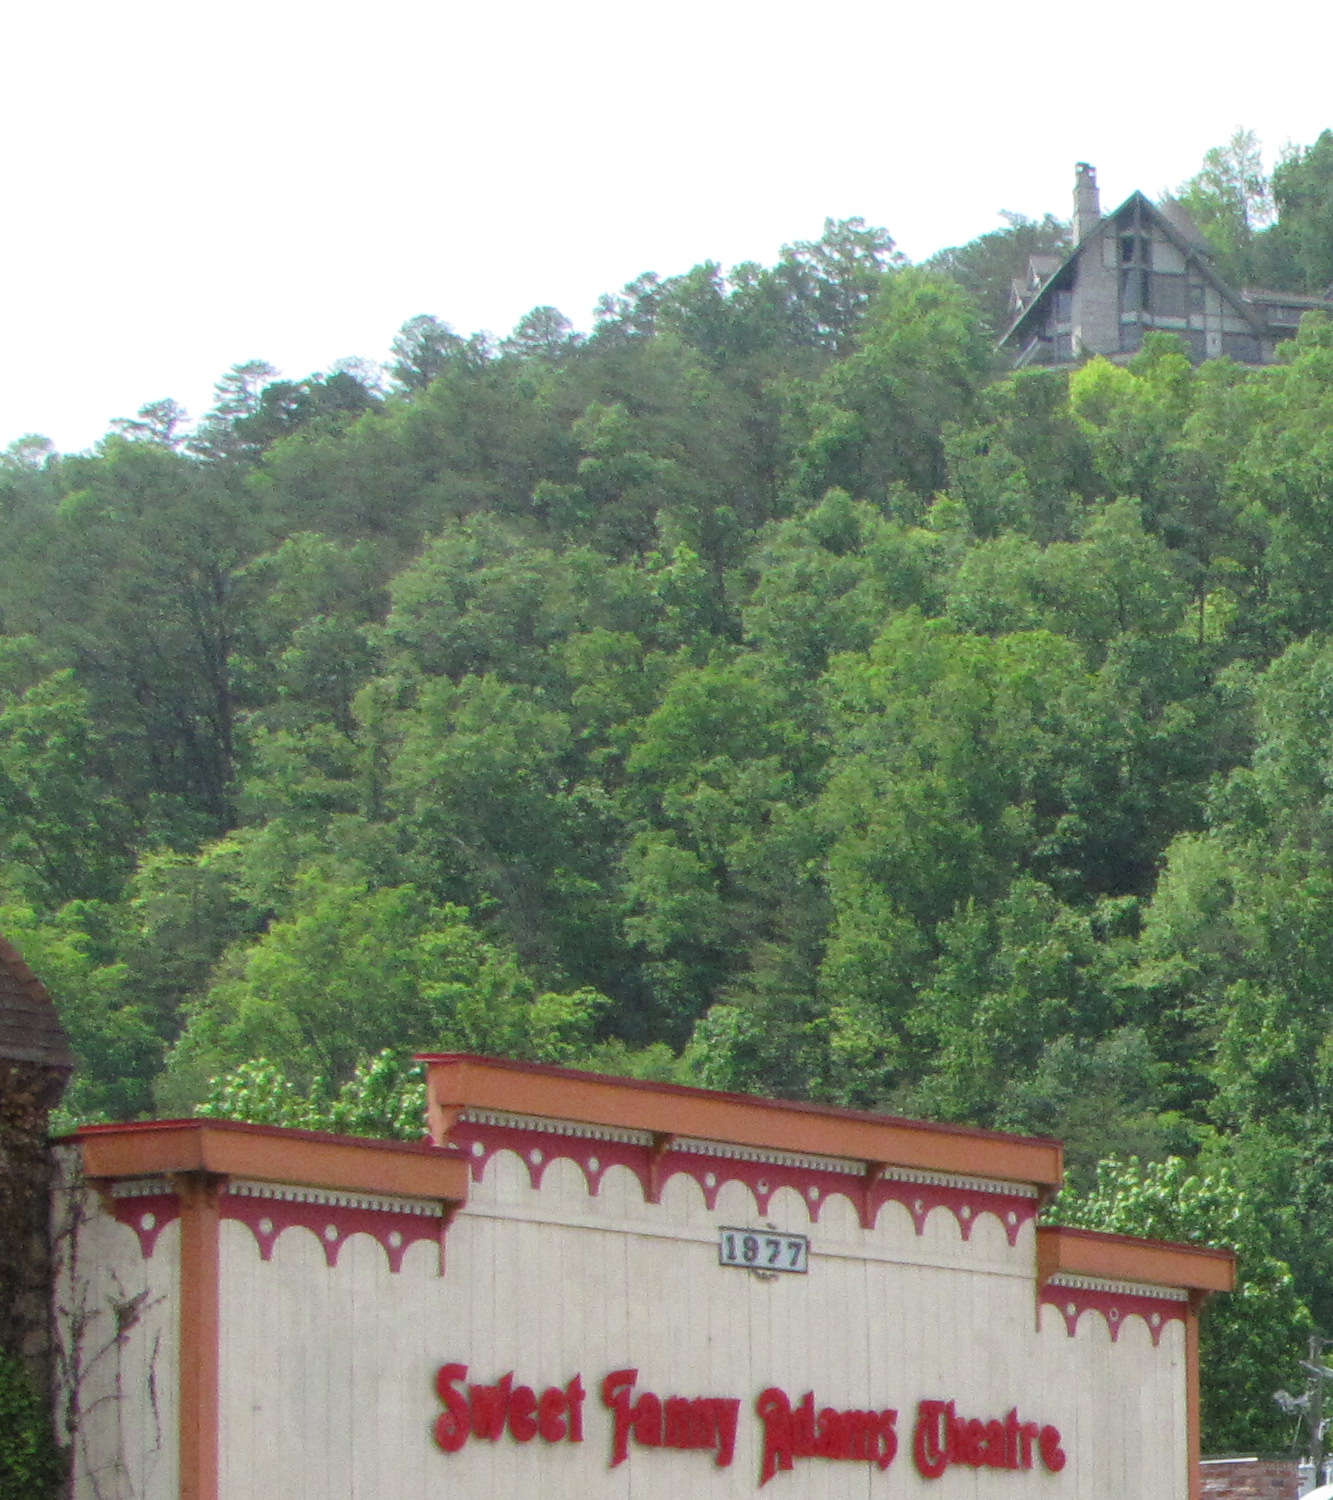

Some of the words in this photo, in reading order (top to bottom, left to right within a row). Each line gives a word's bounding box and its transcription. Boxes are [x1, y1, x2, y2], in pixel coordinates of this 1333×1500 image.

[434, 1362, 586, 1454] Sweet
[601, 1368, 741, 1468] Fanny
[756, 1388, 898, 1489] Adams
[914, 1399, 1066, 1480] Theatre
